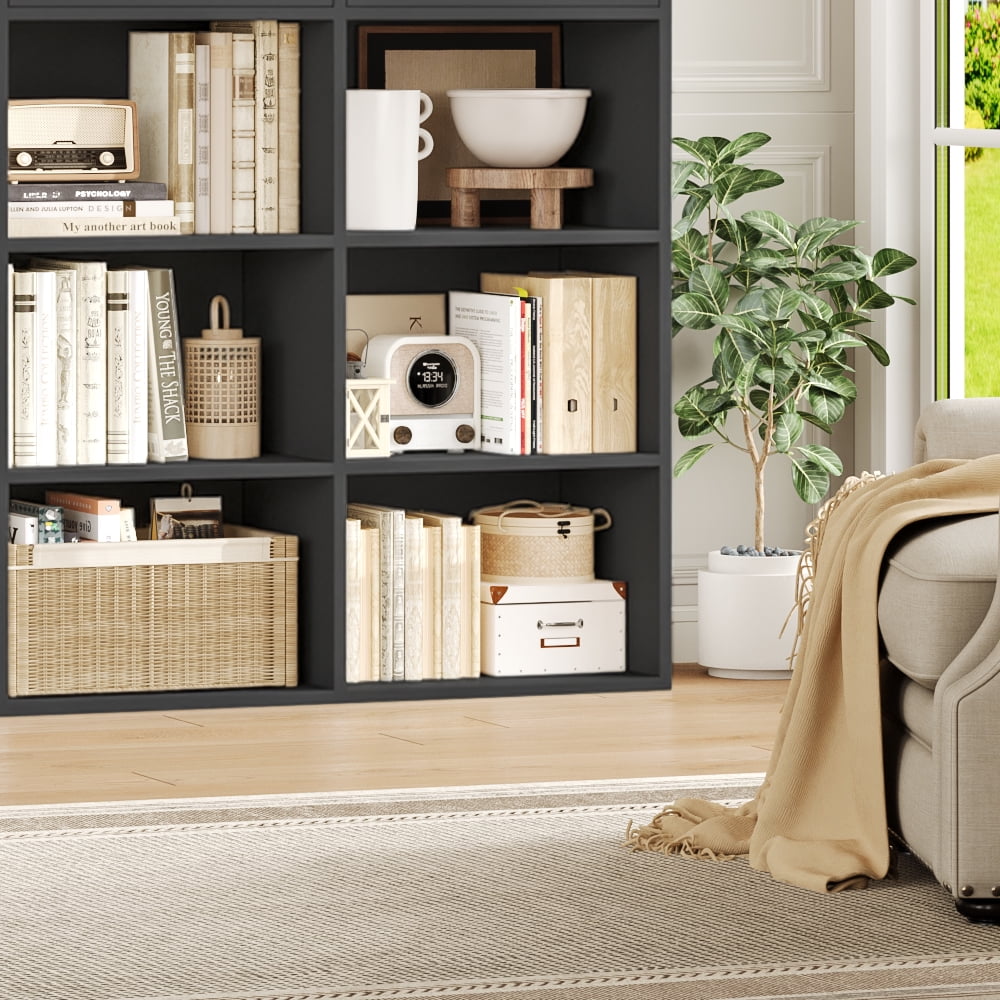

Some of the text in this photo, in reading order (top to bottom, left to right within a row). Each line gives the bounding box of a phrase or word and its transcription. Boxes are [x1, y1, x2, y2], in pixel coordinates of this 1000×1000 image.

[74, 190, 131, 198] PSYCHOLOGY
[63, 220, 177, 234] My another art book
[155, 292, 181, 425] YOUNG THE SHACK
